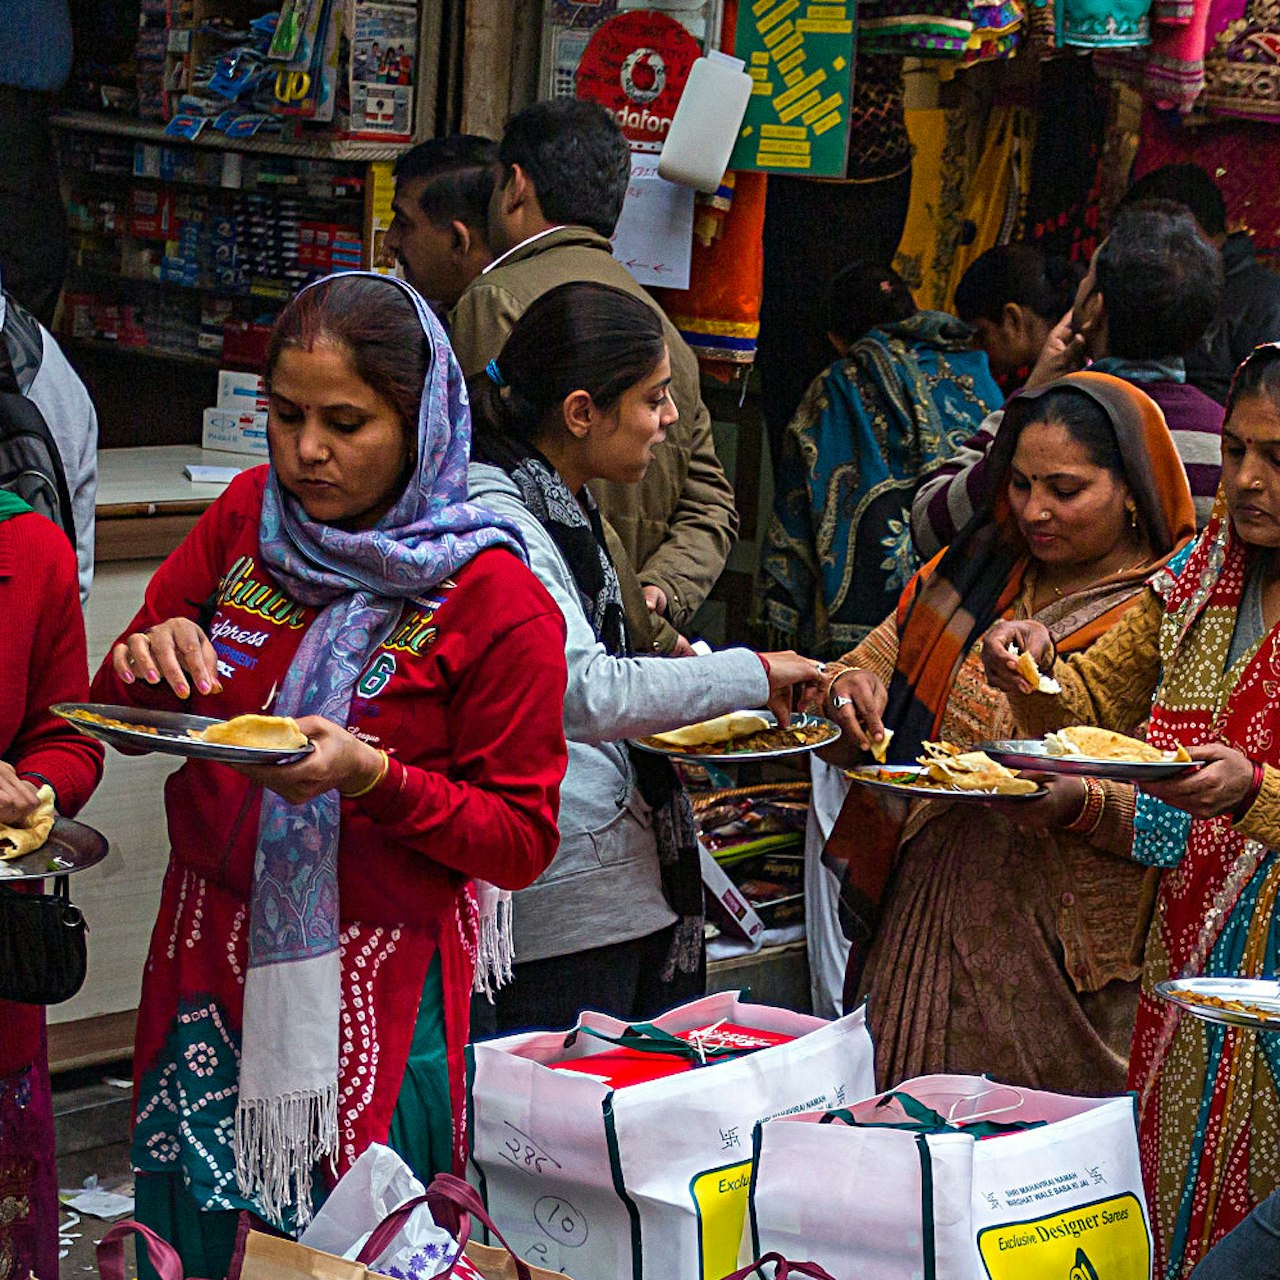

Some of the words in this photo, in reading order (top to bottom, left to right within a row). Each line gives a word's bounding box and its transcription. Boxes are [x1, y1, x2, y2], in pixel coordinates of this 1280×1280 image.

[211, 611, 270, 647] xpress
[357, 652, 397, 699] 6
[1033, 1188, 1054, 1200] WALE
[1053, 1183, 1072, 1195] BABA
[998, 1233, 1038, 1251] Exclusive
[1036, 1213, 1099, 1242] Designer
[1102, 1206, 1129, 1226] Sarees
